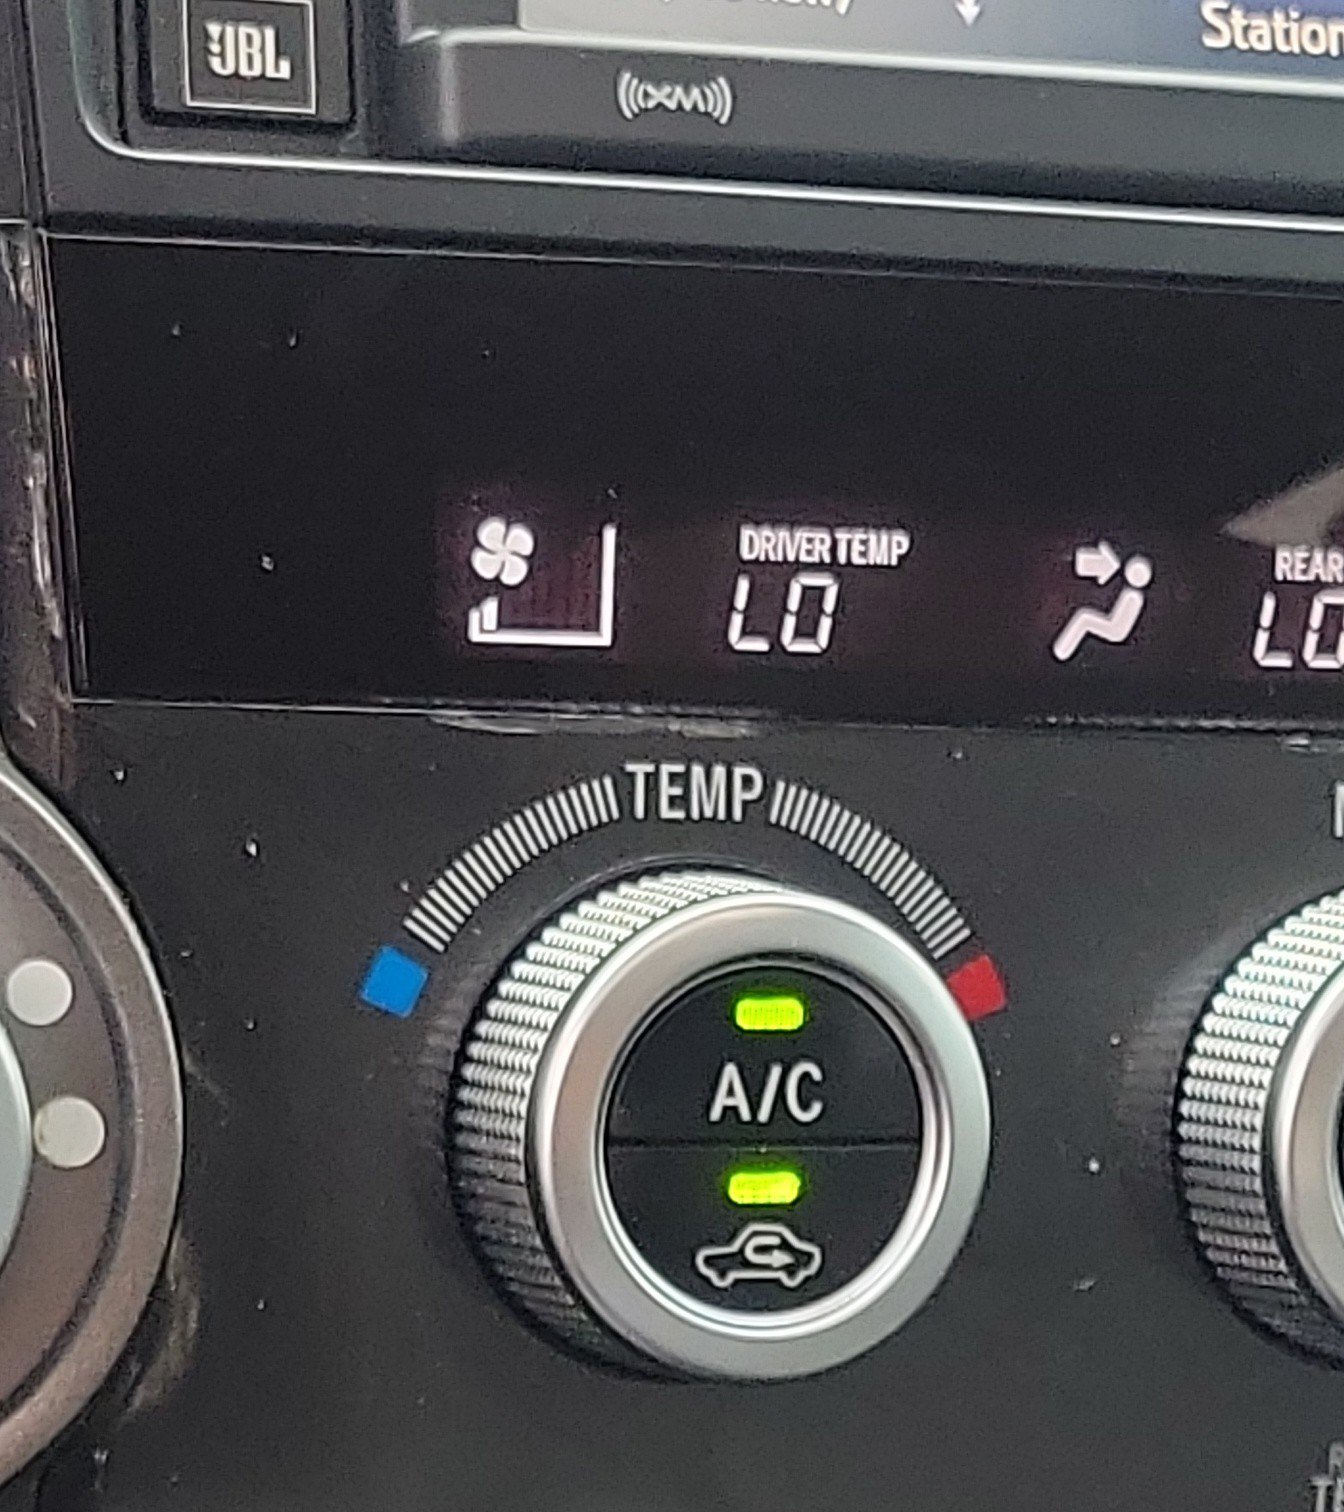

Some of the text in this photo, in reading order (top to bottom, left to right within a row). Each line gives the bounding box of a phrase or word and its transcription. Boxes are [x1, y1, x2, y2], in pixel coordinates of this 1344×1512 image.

[205, 22, 292, 81] JBL
[739, 524, 912, 567] DRIVER TEMP
[623, 761, 765, 823] TEMP
[708, 1060, 825, 1125] A/C
